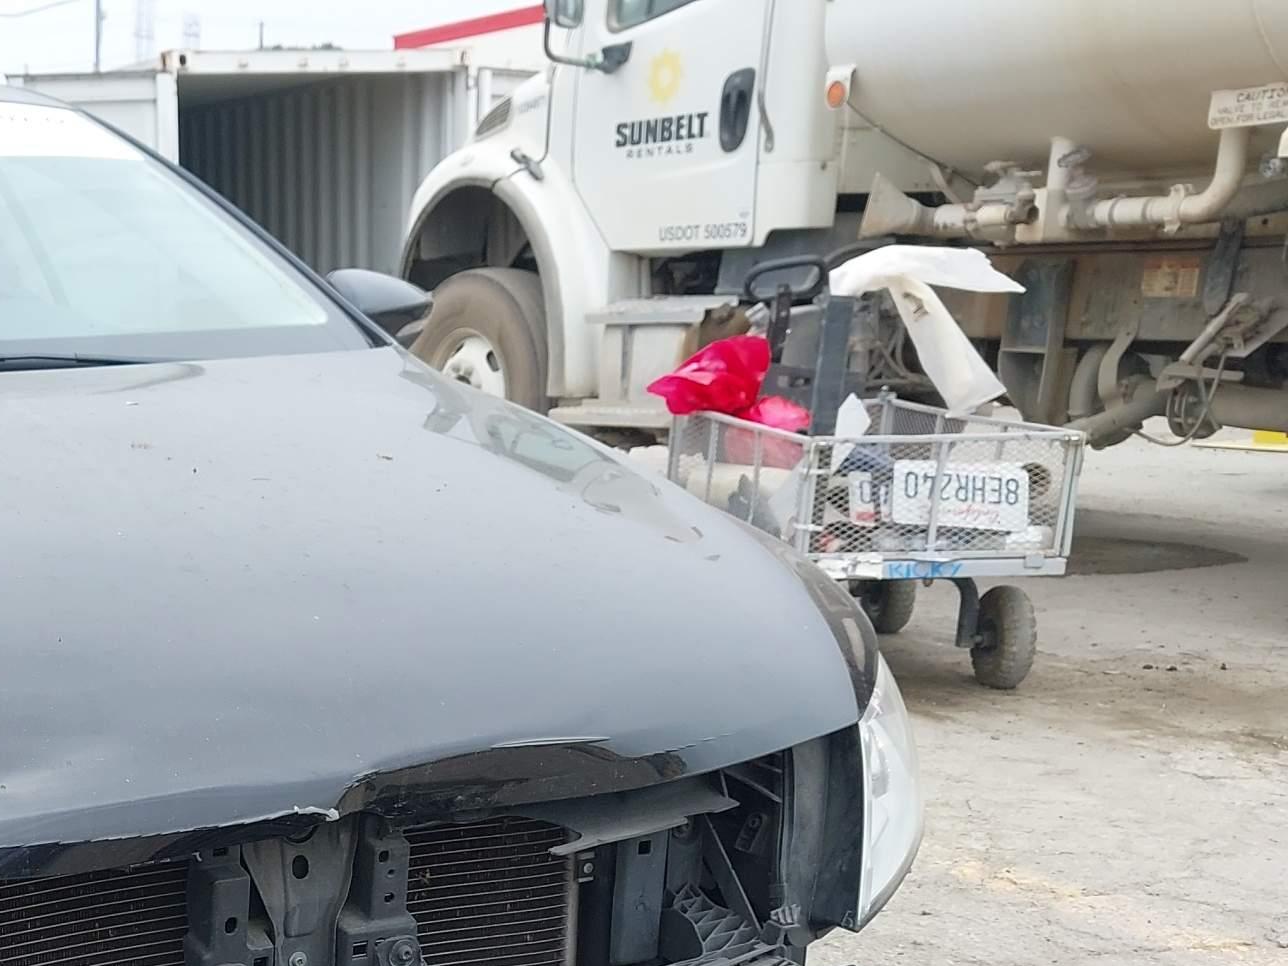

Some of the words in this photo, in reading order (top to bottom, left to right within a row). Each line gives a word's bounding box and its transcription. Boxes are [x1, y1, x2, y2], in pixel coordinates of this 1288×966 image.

[1236, 87, 1288, 103] CAUTIO
[615, 112, 709, 148] SUNBELT
[625, 142, 694, 159] RENTALS
[658, 224, 701, 242] USDOT
[904, 471, 1020, 505] 8EHR240
